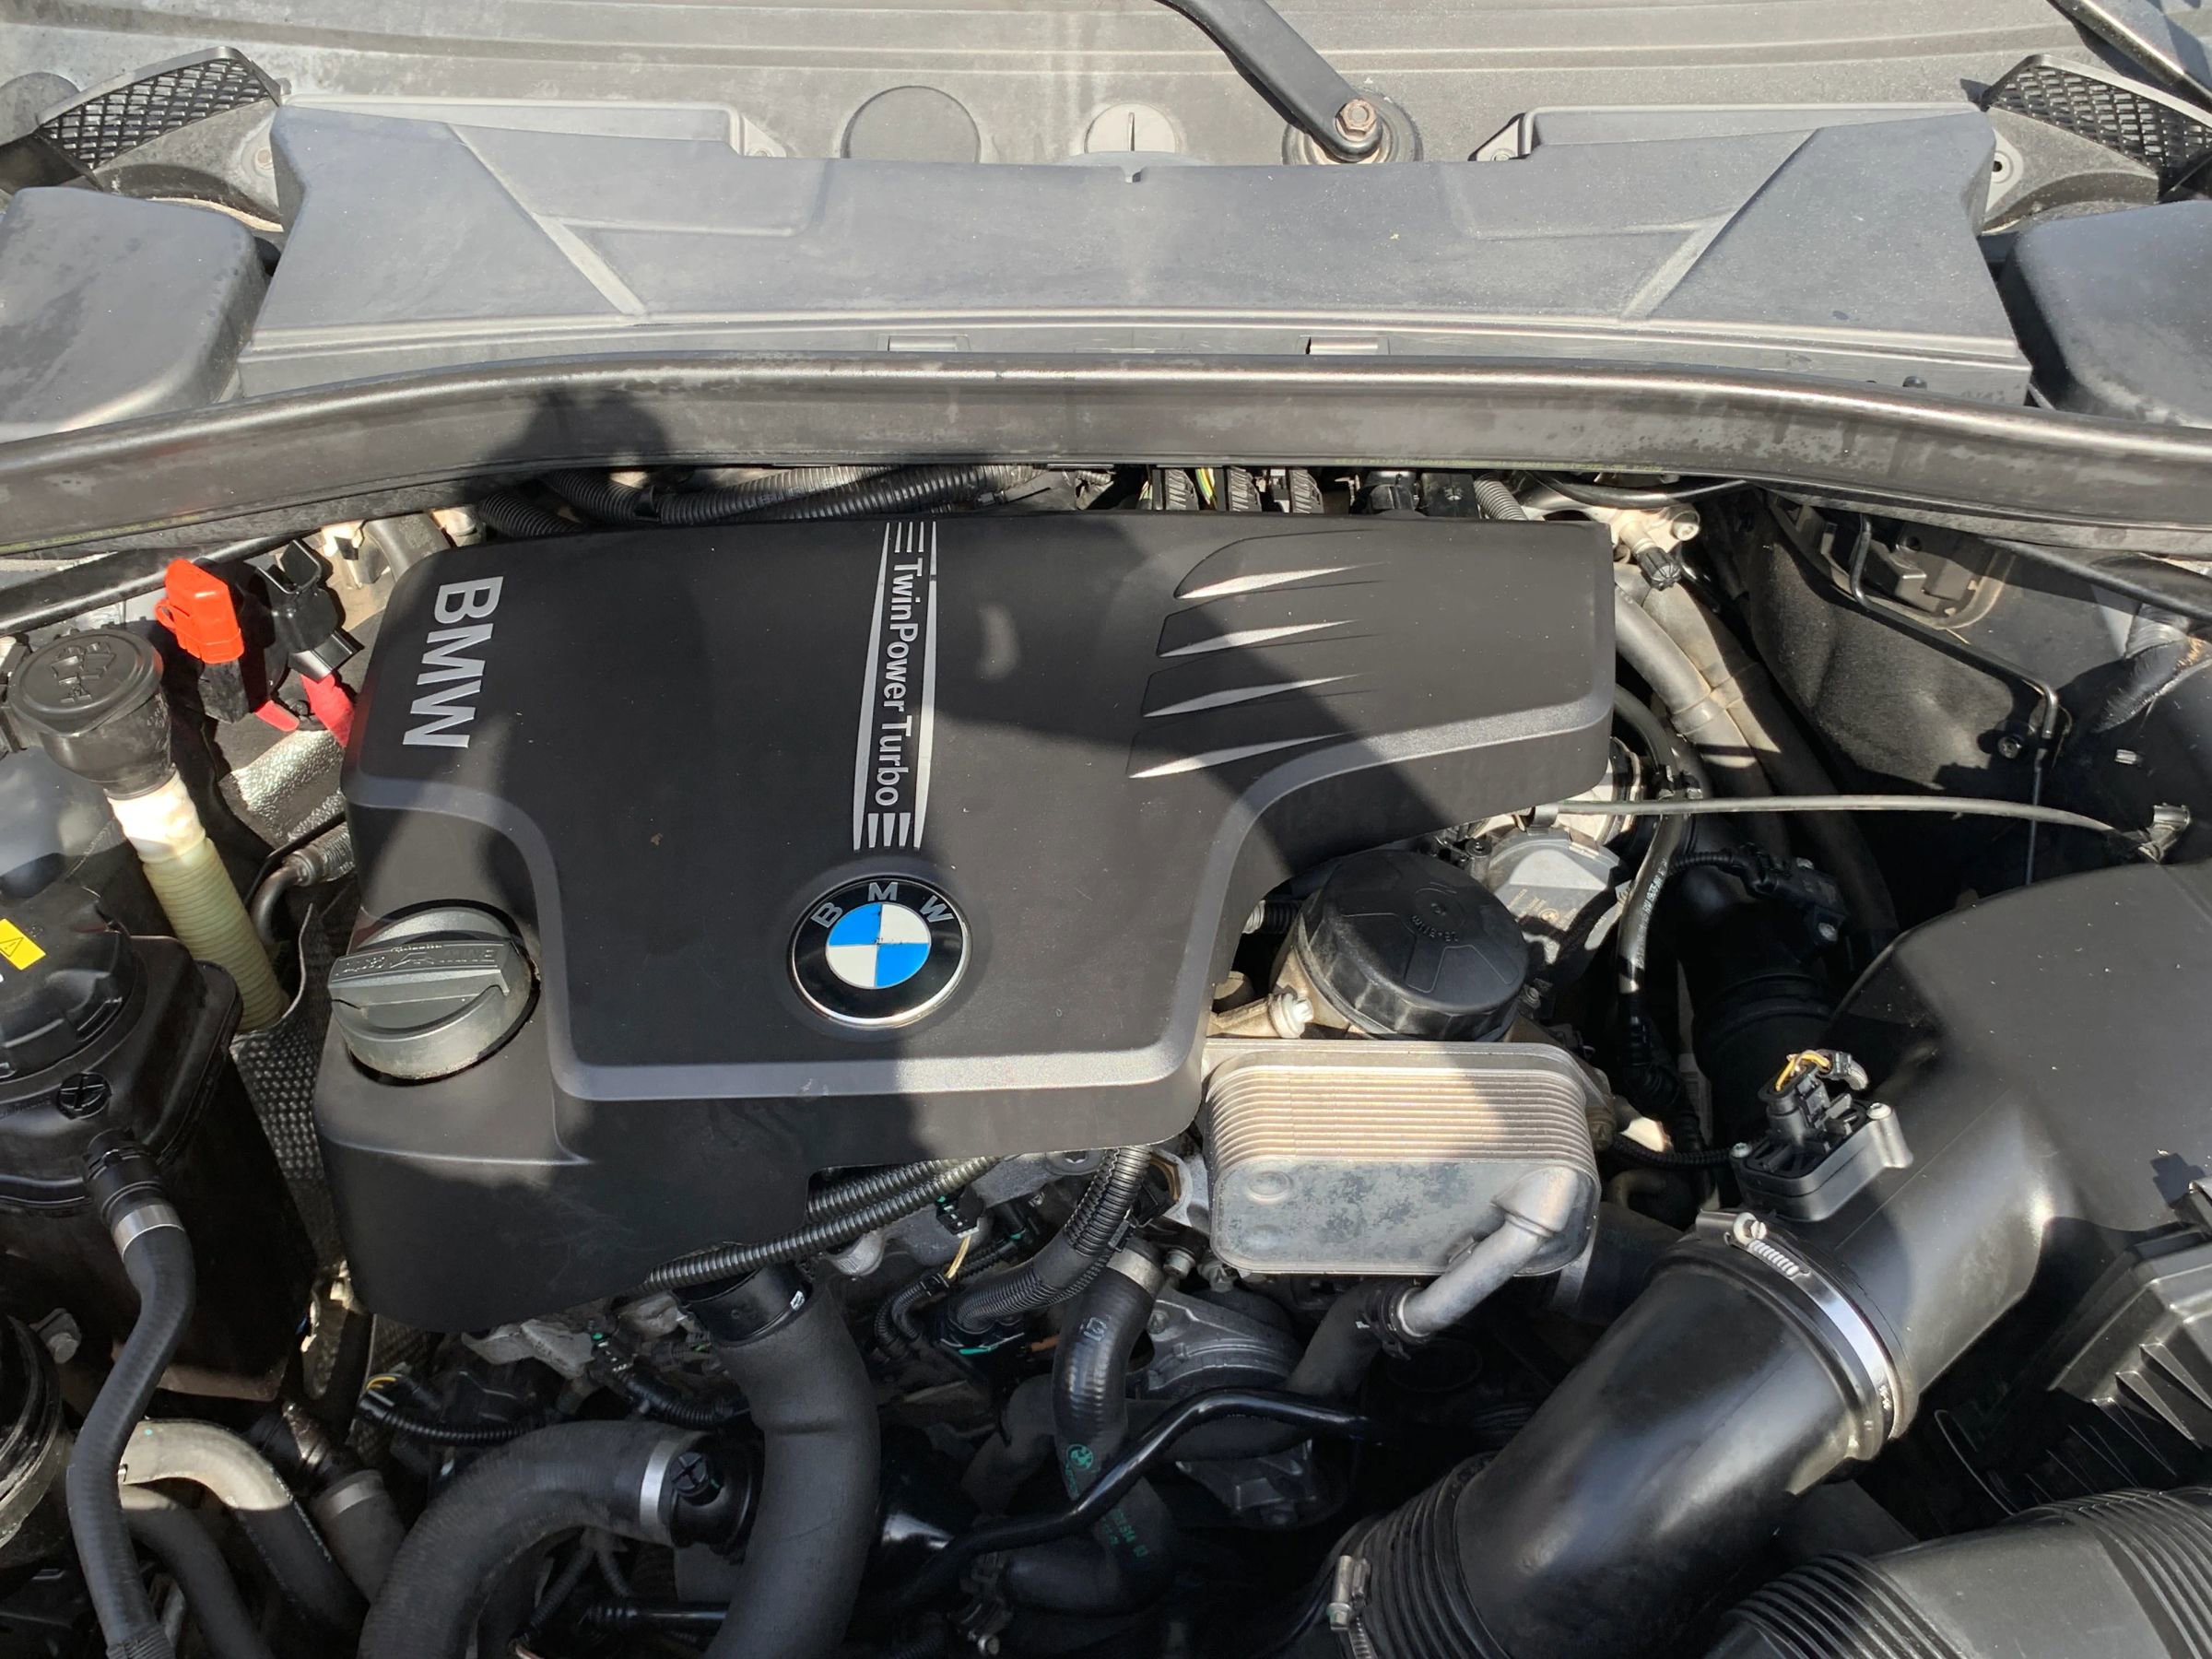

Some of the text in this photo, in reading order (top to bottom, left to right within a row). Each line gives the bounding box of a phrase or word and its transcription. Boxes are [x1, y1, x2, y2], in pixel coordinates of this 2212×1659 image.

[402, 576, 504, 748] BMW
[875, 557, 923, 806] TwinPower Turbo
[810, 881, 955, 929] BMW
